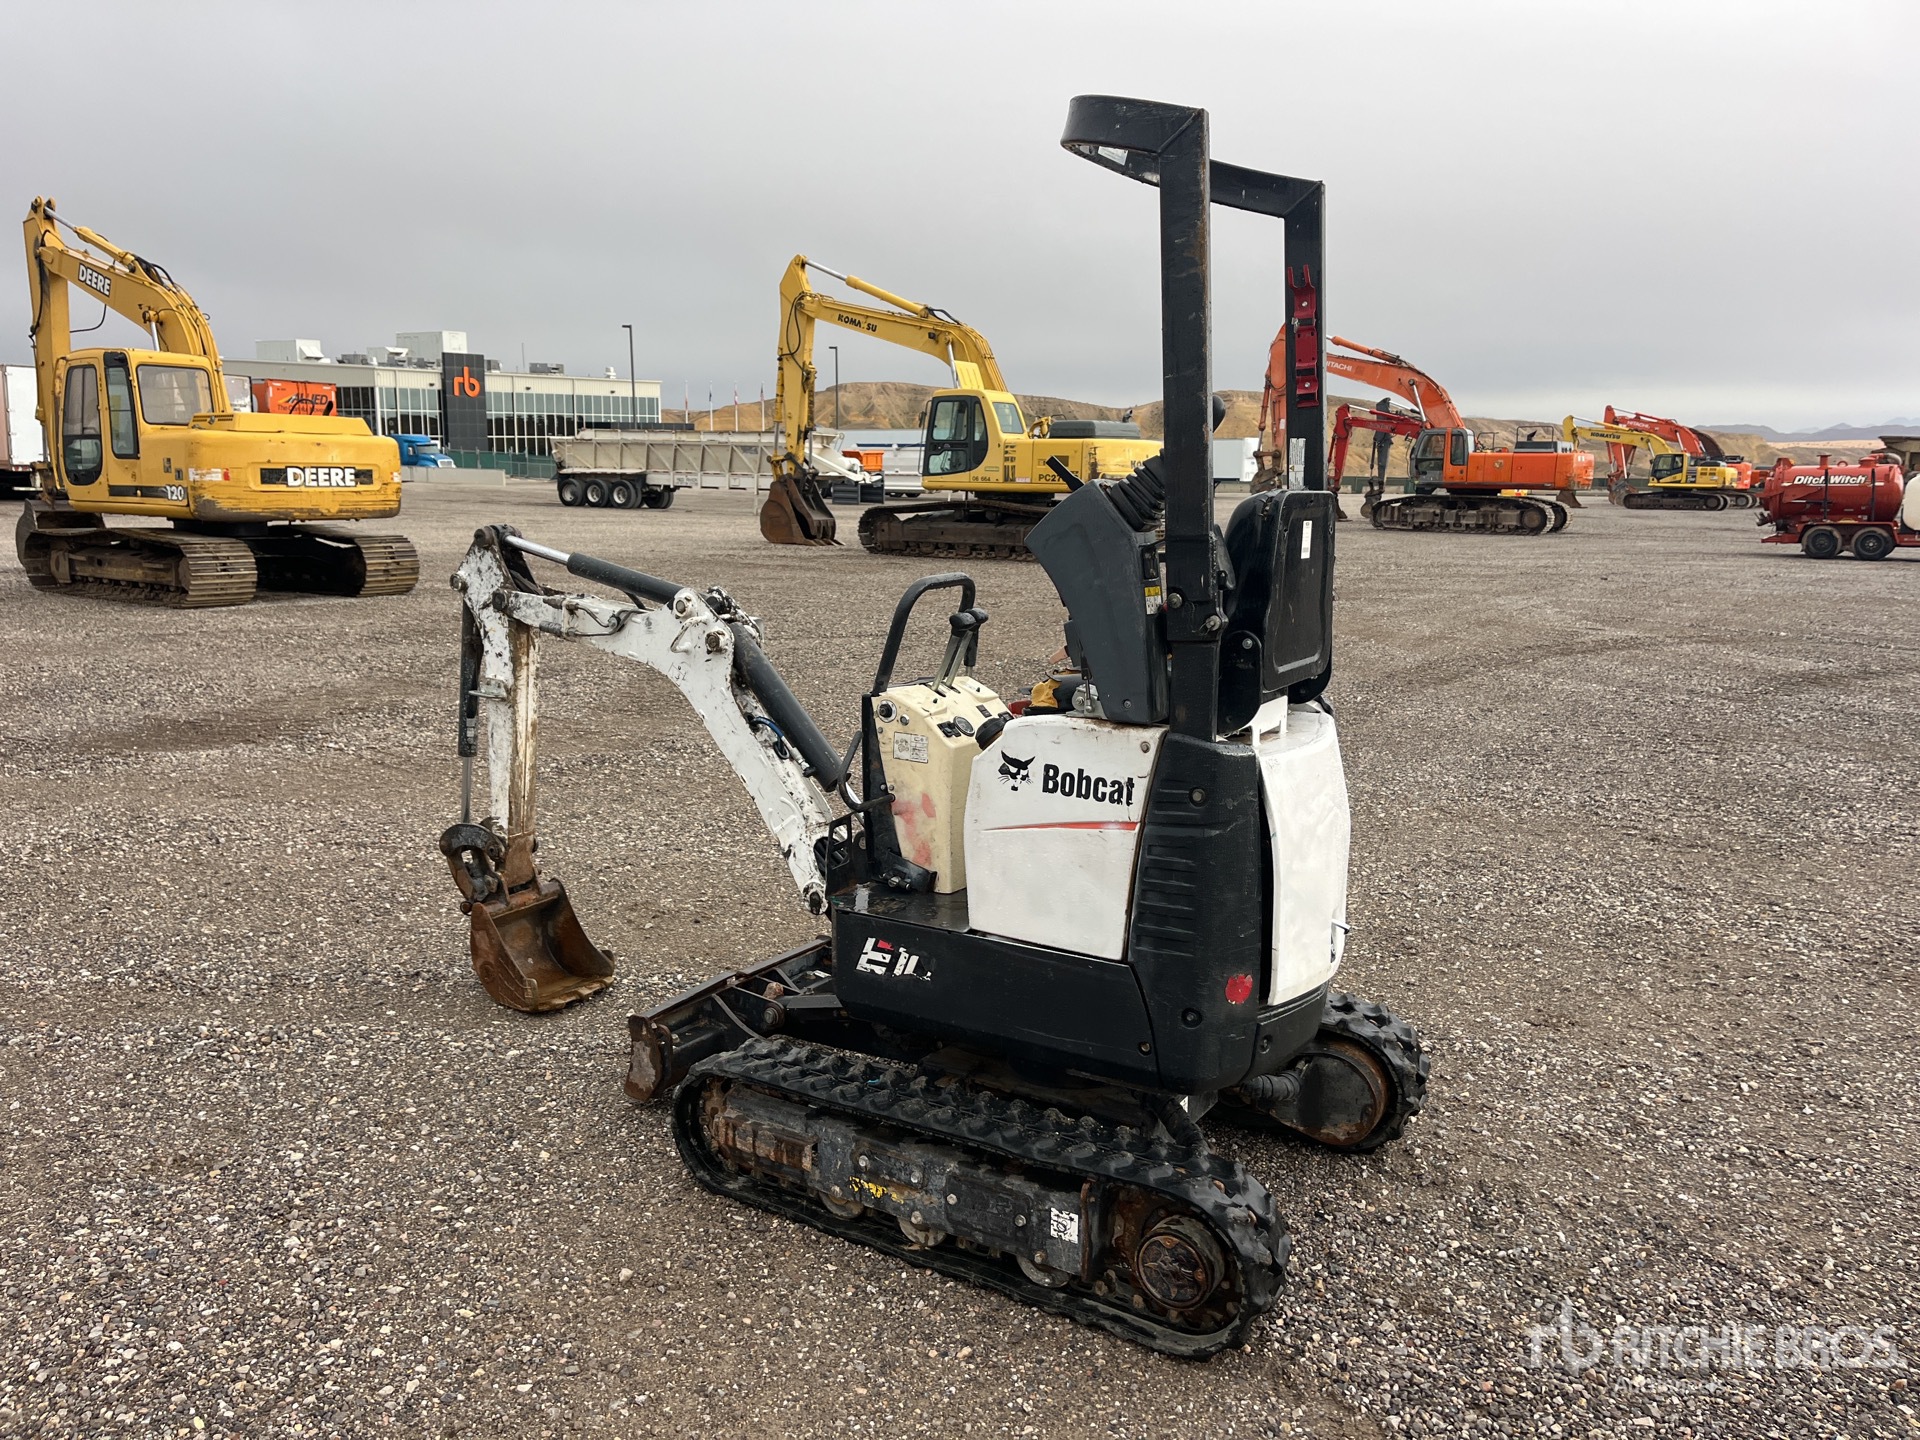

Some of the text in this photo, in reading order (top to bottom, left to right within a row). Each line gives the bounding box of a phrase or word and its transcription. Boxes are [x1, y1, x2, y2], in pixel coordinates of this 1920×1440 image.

[78, 263, 111, 297] DEERE
[837, 313, 878, 333] KOMASU
[453, 366, 481, 398] rb
[1590, 431, 1621, 440] KOMATSU
[285, 466, 356, 487] DEERE
[1038, 473, 1062, 483] PC27
[1829, 475, 1867, 484] Witch
[165, 485, 185, 501] 120
[1042, 763, 1135, 807] Bobcat
